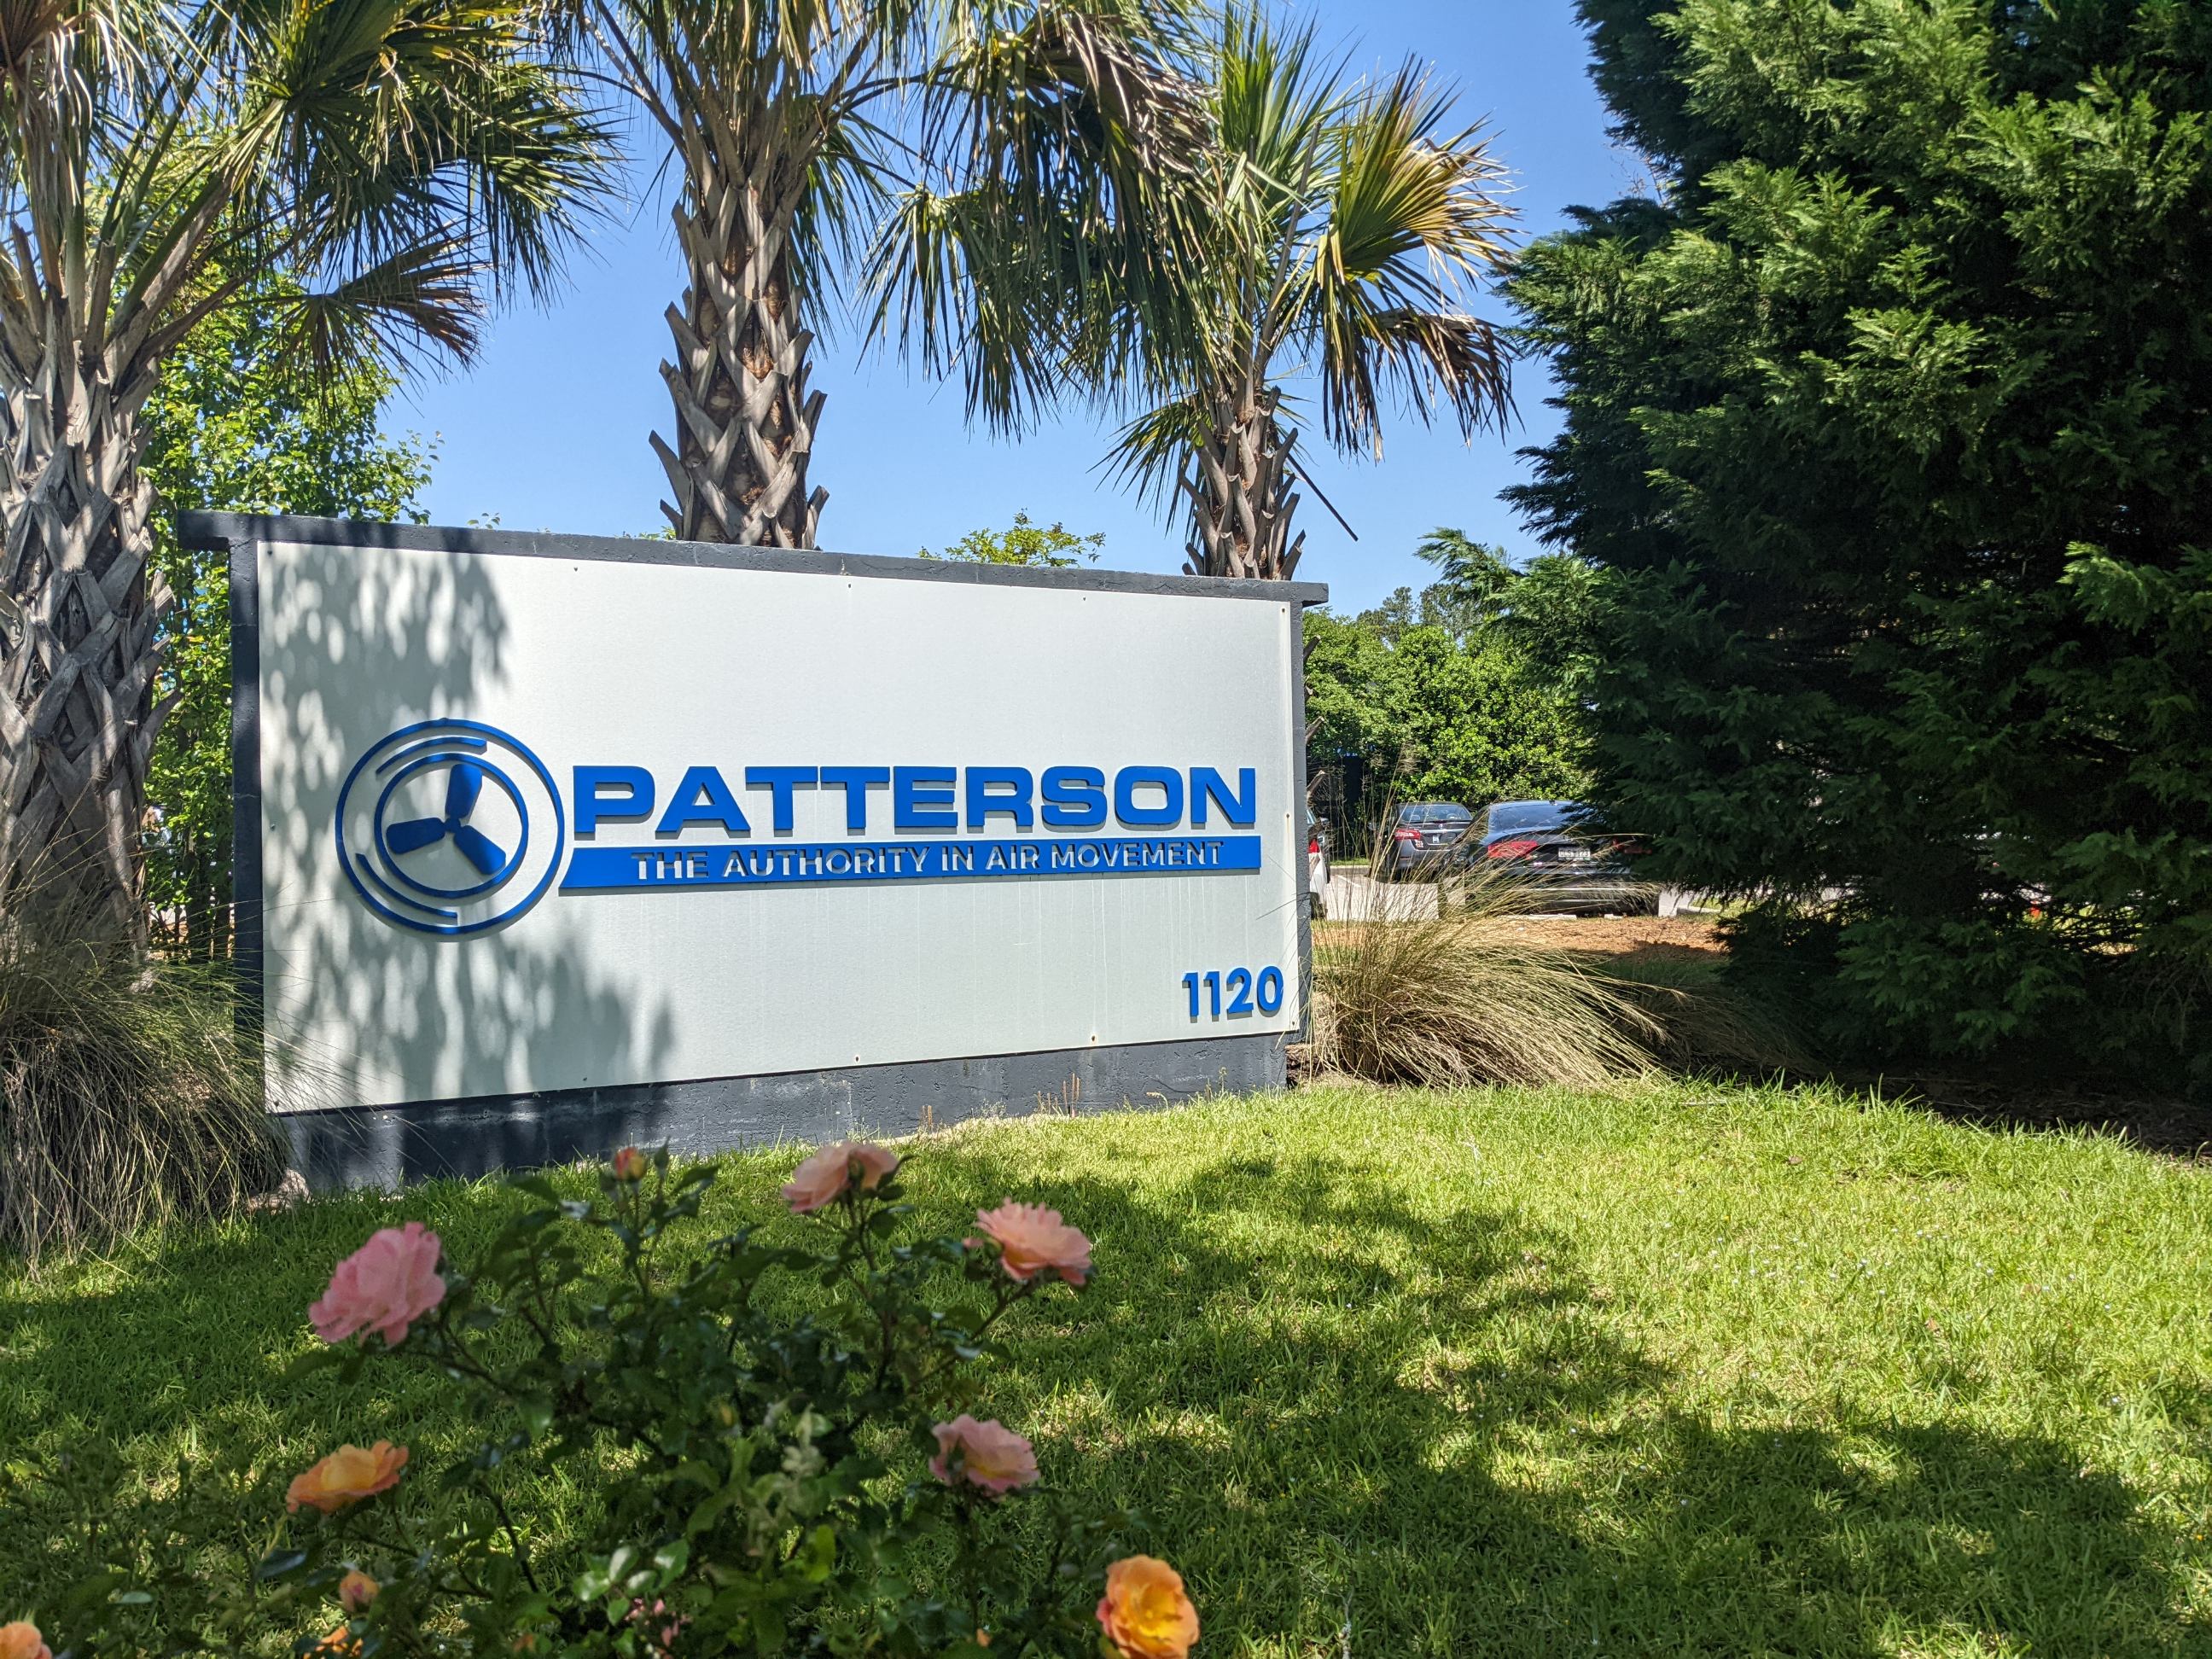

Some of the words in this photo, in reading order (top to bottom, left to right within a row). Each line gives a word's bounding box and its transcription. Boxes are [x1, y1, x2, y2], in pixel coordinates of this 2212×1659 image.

[572, 765, 1256, 833] PATTERSON
[631, 850, 709, 880] THE
[723, 846, 930, 878] AUTHORITY
[941, 845, 975, 871] IN
[985, 844, 1040, 870] AIR
[1051, 841, 1225, 869] MOVEMENT
[1182, 965, 1284, 1018] 1120
